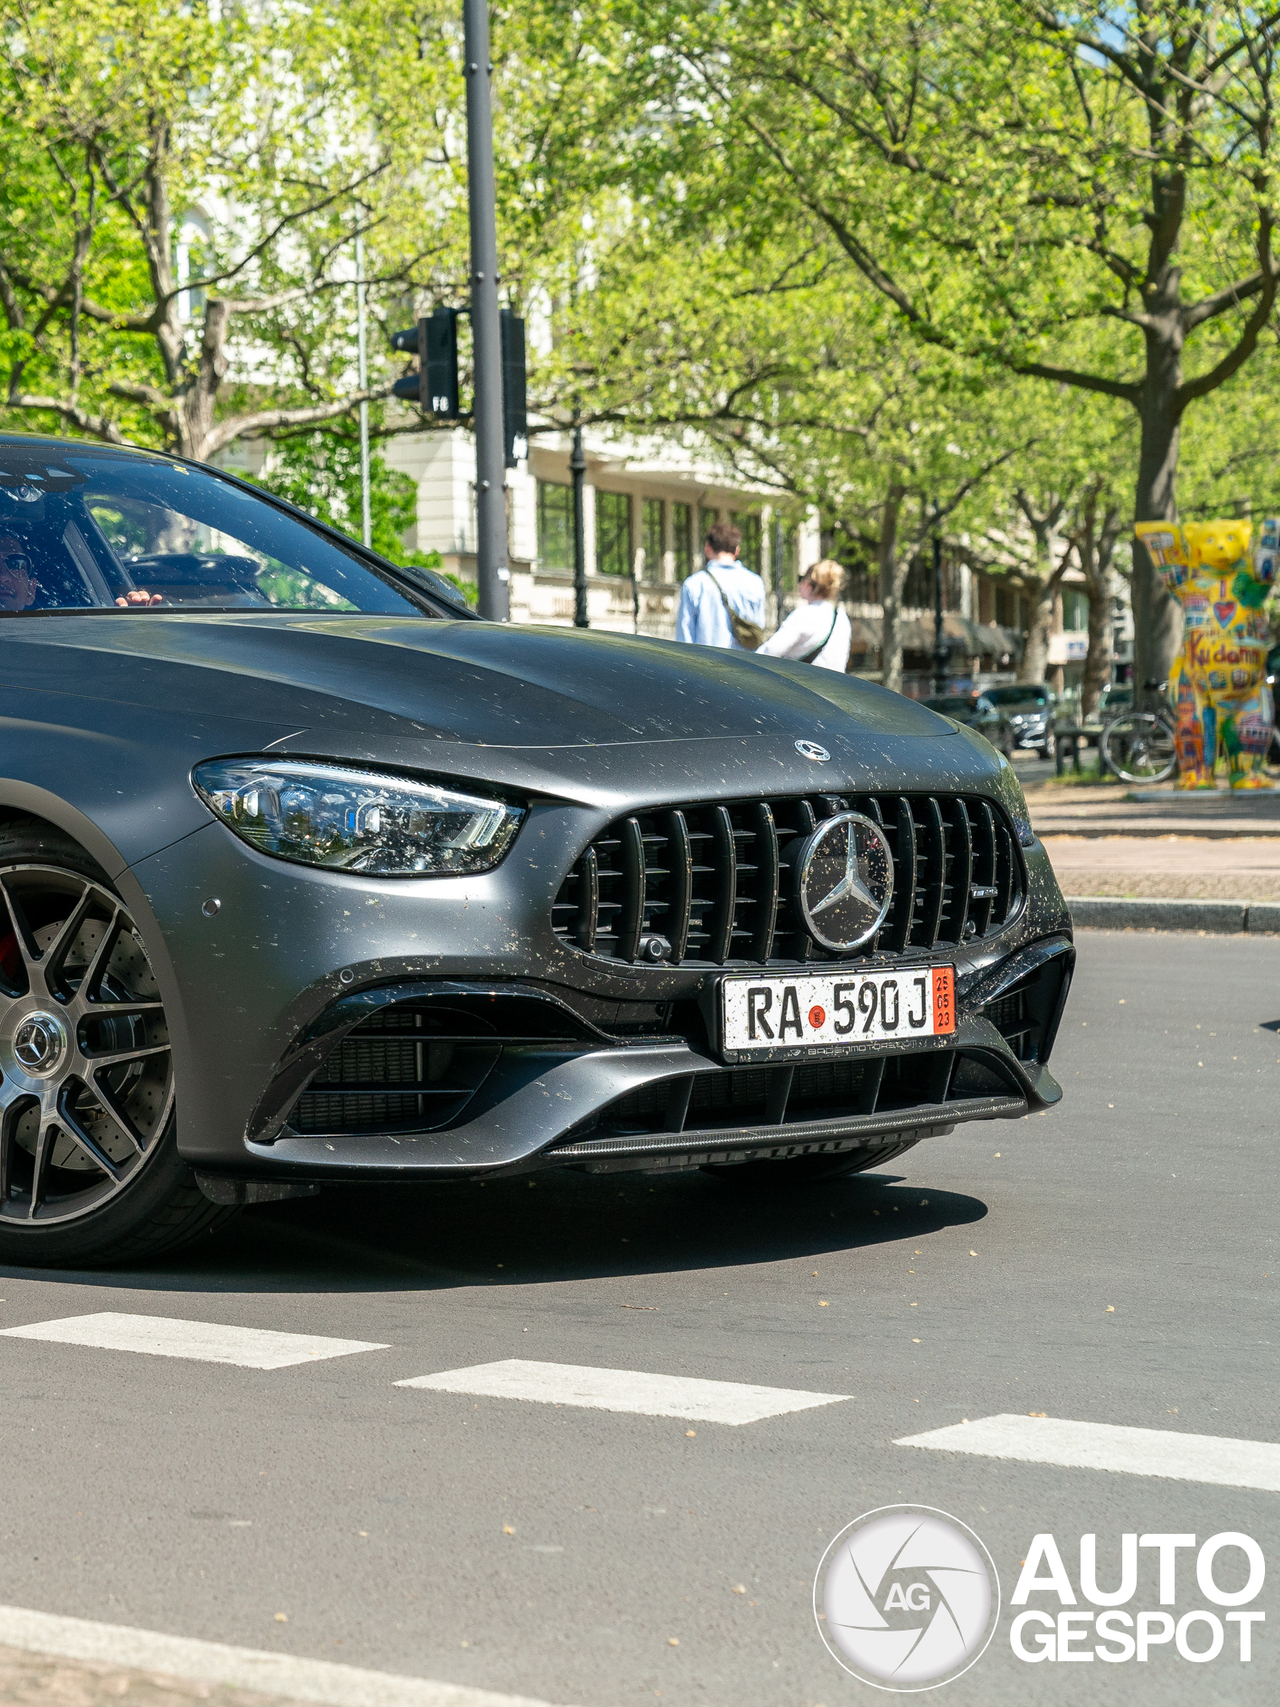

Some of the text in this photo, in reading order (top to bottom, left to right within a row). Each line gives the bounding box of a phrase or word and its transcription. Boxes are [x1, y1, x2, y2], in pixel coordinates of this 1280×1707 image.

[936, 976, 948, 991] 25
[937, 993, 949, 1008] 05
[747, 985, 803, 1040] RA
[937, 1012, 950, 1027] 23
